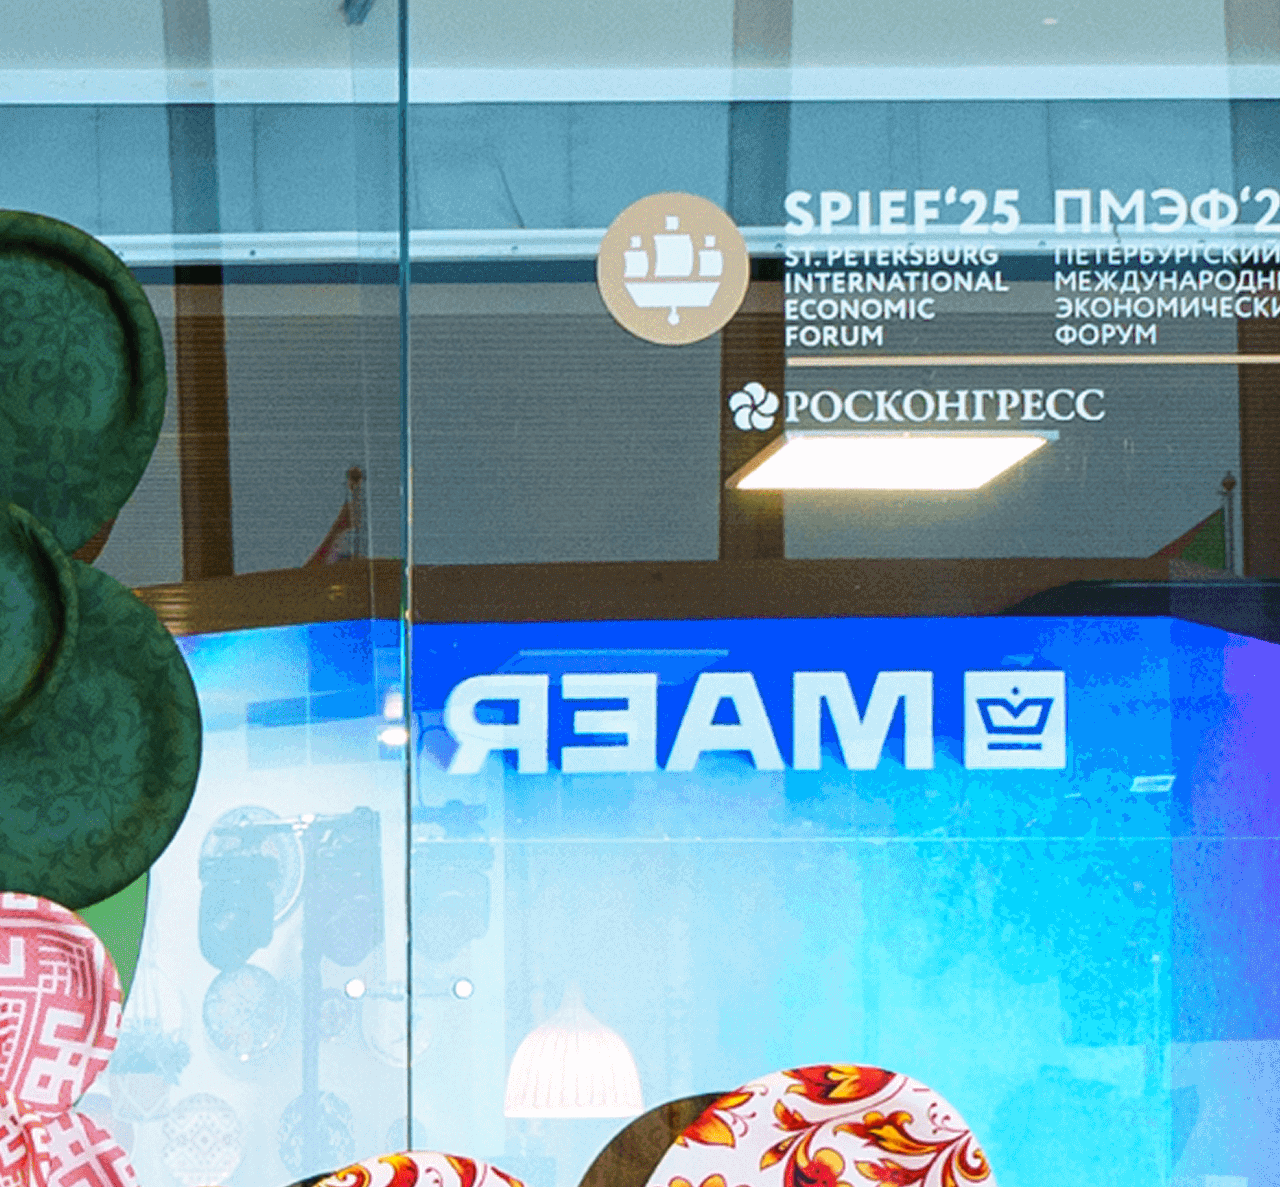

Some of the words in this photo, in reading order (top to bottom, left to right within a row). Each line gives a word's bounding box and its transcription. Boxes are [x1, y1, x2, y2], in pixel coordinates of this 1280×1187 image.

[785, 245, 821, 267] ST.
[827, 244, 999, 266] PETERSBURG
[1054, 240, 1280, 265] ПЕТЕРБУРГСКИЙ
[785, 271, 1010, 294] INTERNATIONAL
[1054, 270, 1280, 294] МЕЖДУНАРОДН
[785, 298, 936, 321] ECONOMIC
[785, 325, 884, 347] FORUM
[1055, 323, 1158, 346] ФОРУМ
[784, 389, 1106, 423] РОСКОНГРЕСС
